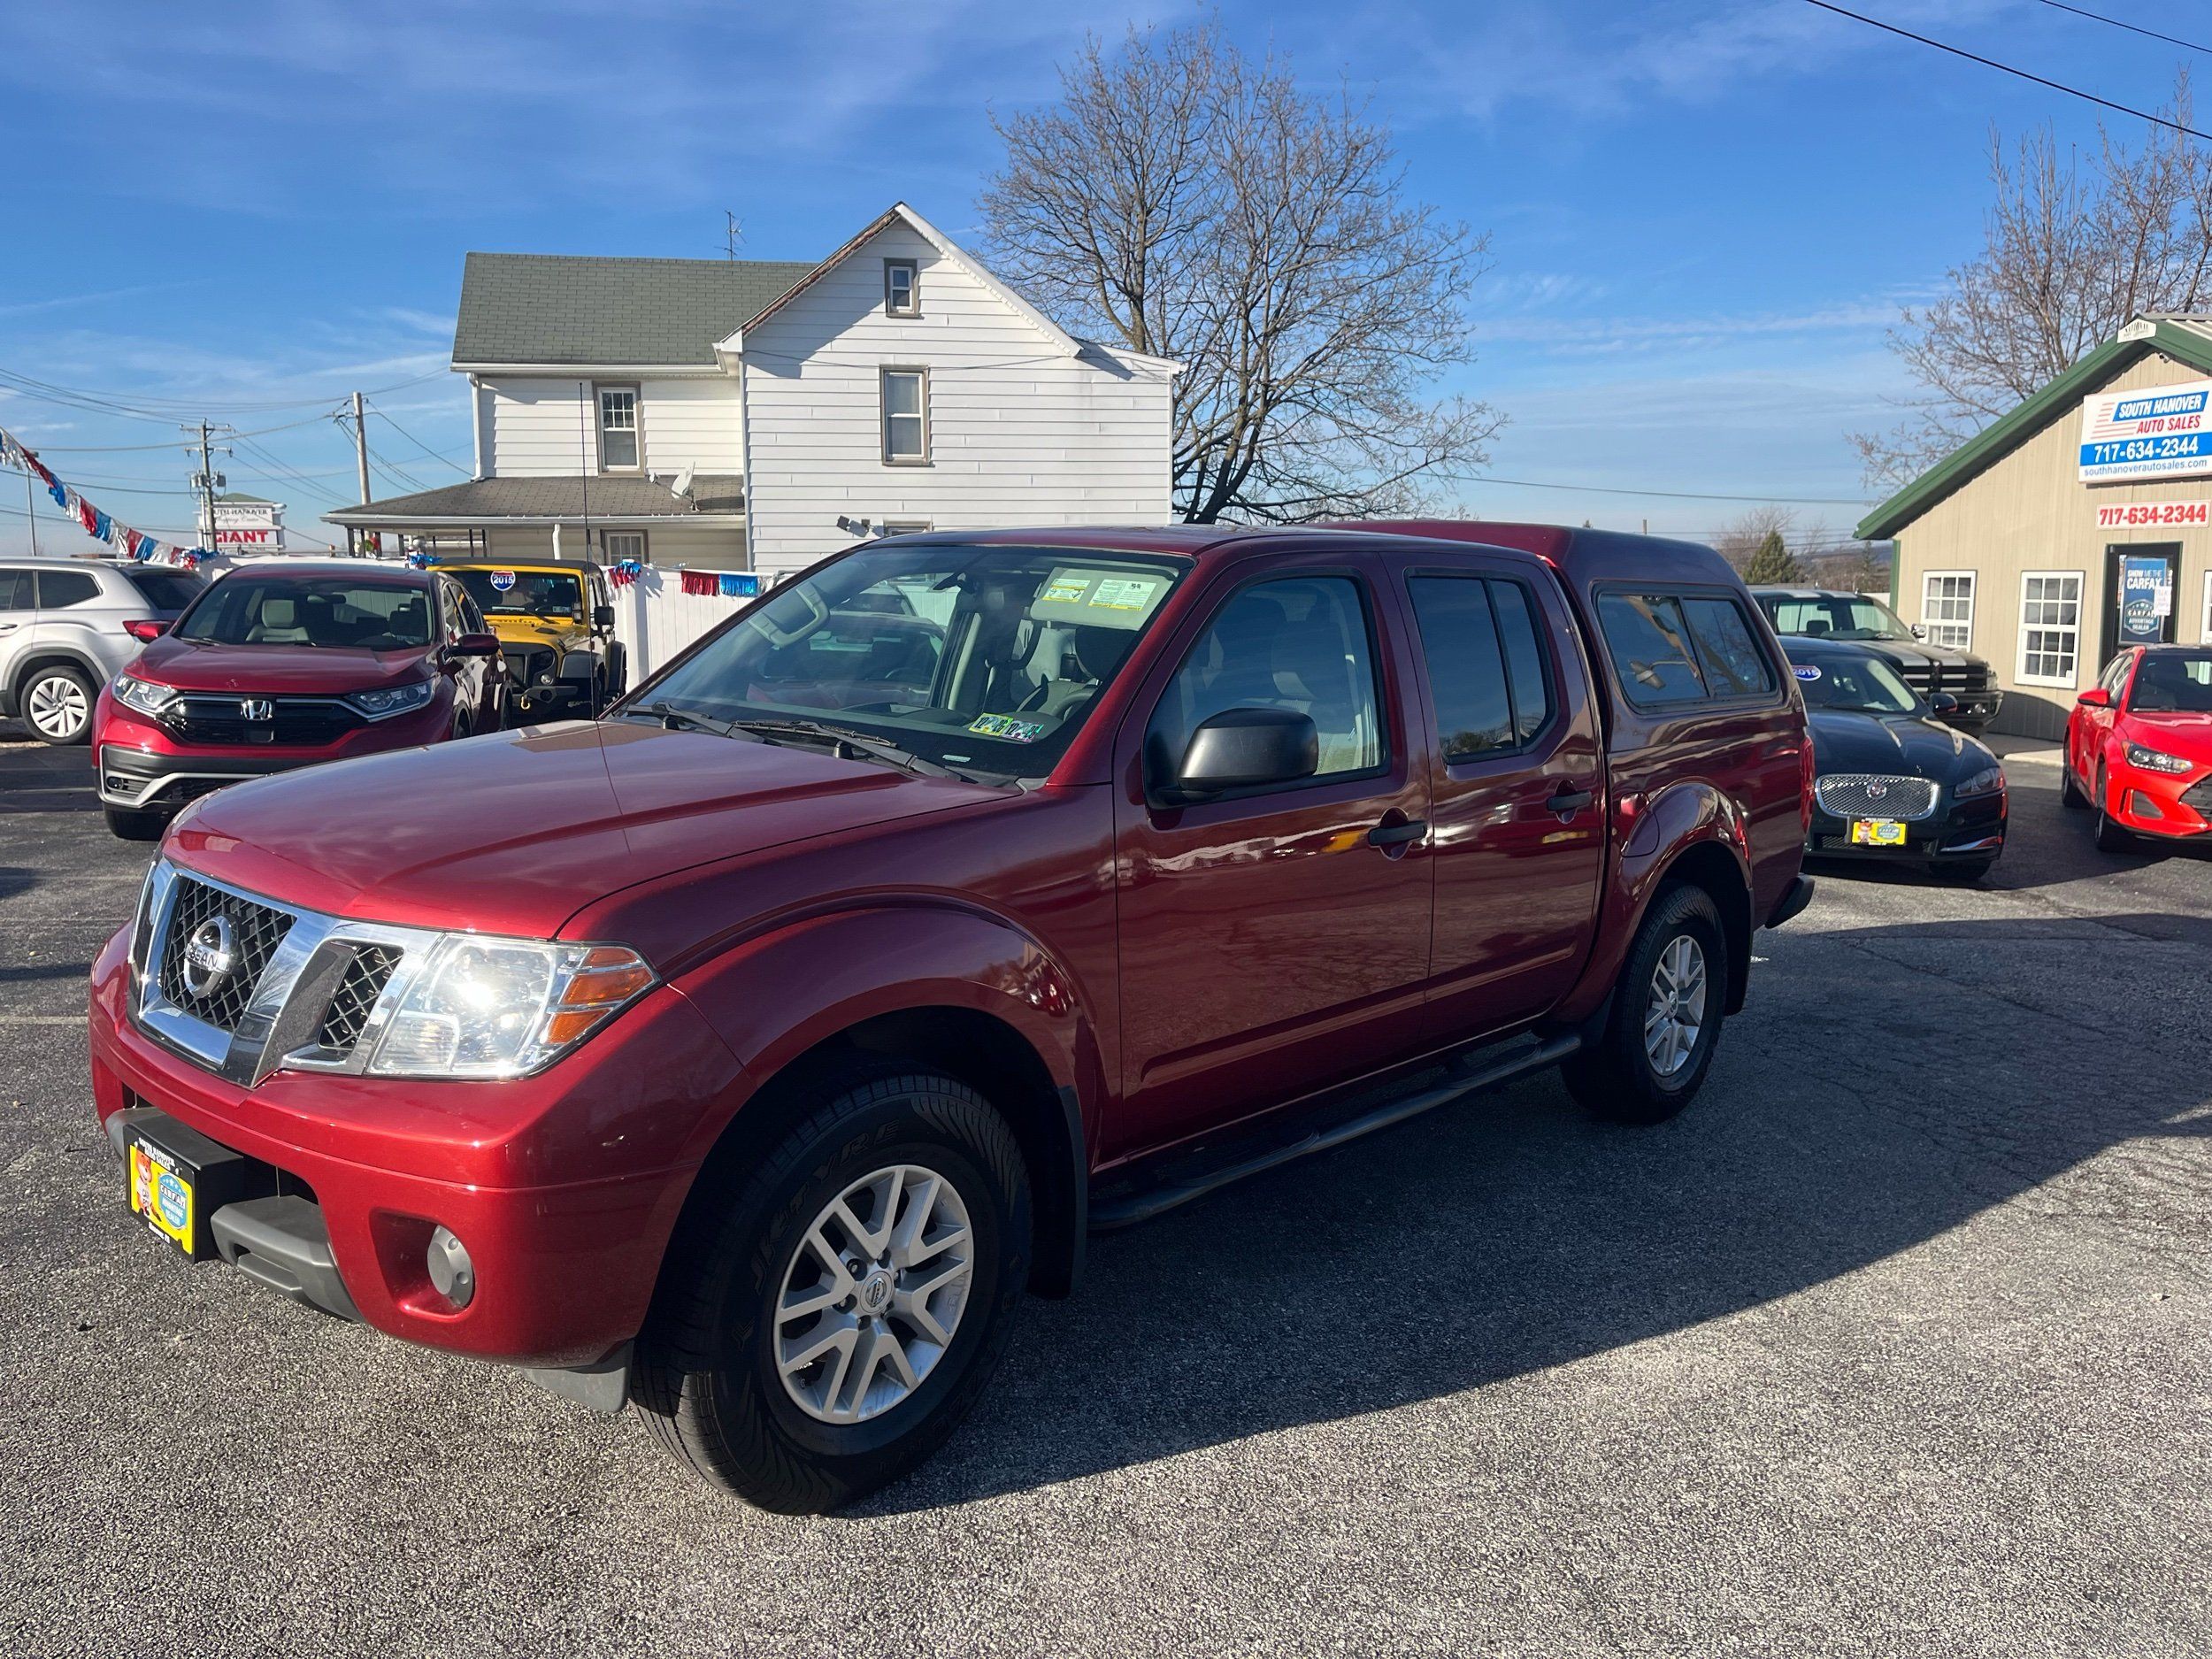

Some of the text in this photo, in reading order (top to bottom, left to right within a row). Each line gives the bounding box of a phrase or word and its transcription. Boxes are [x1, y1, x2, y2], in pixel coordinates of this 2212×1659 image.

[2118, 394, 2203, 419] SOUTH HANOVER
[2136, 414, 2201, 434] AUTO SALES
[2094, 435, 2199, 463] 717-634-2344
[2084, 459, 2208, 477] southhanoverautosales.com
[2099, 504, 2207, 525] 717-634-2344
[215, 530, 268, 543] GIANT
[2126, 578, 2163, 590] CARFAX
